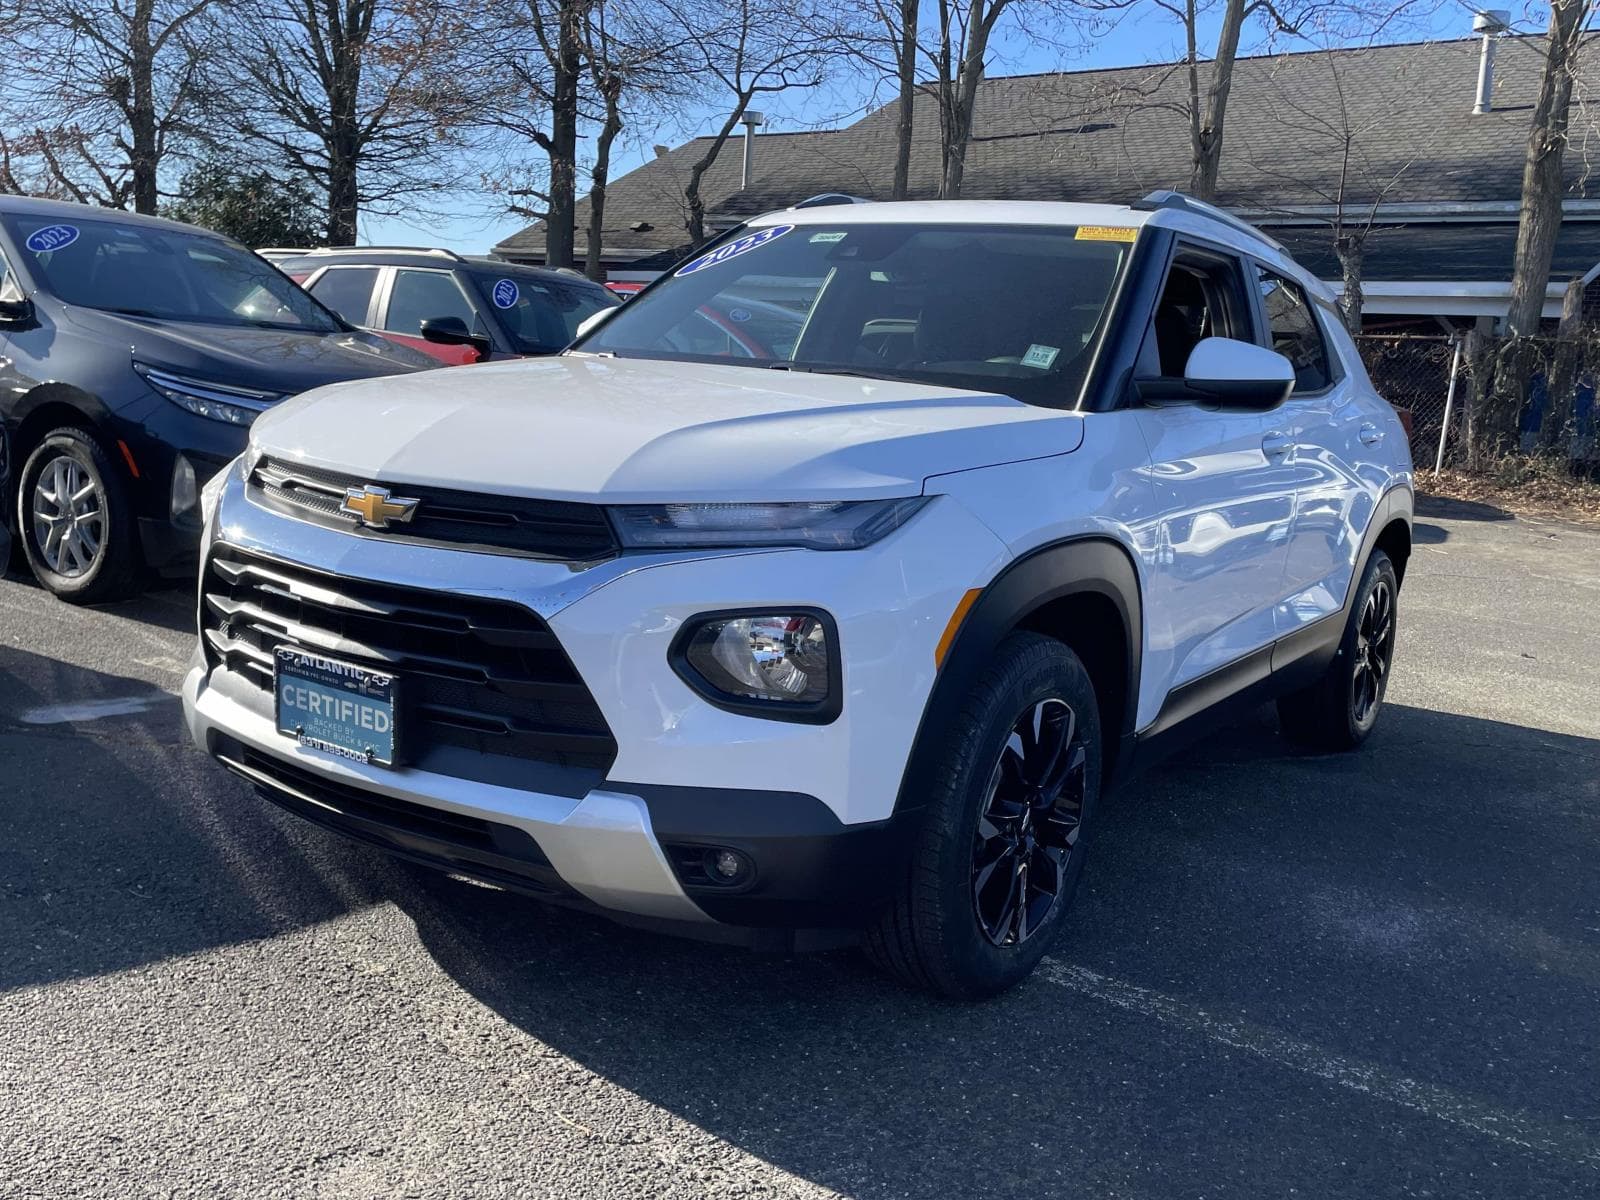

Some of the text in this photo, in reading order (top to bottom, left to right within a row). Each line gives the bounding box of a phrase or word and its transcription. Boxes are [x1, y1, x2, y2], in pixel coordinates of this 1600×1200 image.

[34, 226, 71, 249] 2023
[696, 228, 775, 270] 2023
[300, 655, 364, 680] ATLANTIC
[282, 684, 389, 733] CERTIFIED
[290, 719, 331, 737] CHEVROLET
[333, 732, 355, 745] BUICK
[314, 717, 354, 735] BACKED BY
